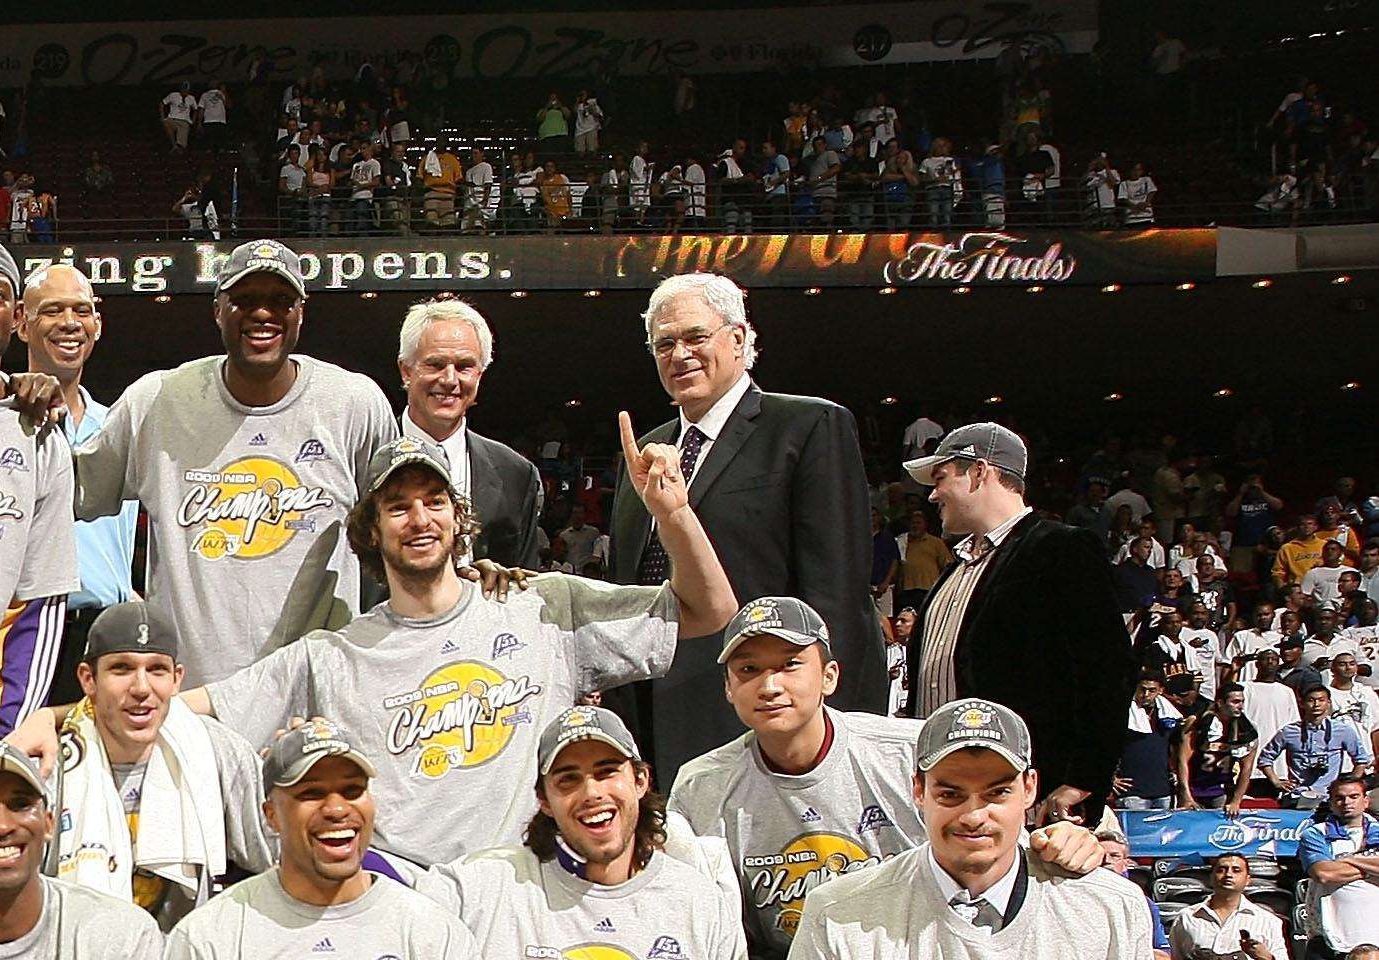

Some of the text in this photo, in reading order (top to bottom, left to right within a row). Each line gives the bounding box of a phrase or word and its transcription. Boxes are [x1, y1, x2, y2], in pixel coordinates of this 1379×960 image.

[897, 241, 966, 281] The
[224, 473, 257, 485] NBA
[178, 486, 334, 544] Champions
[425, 682, 459, 697] NBA
[387, 676, 542, 754] Champions
[948, 731, 1001, 741] CHAMPIONS
[744, 856, 784, 867] 2009
